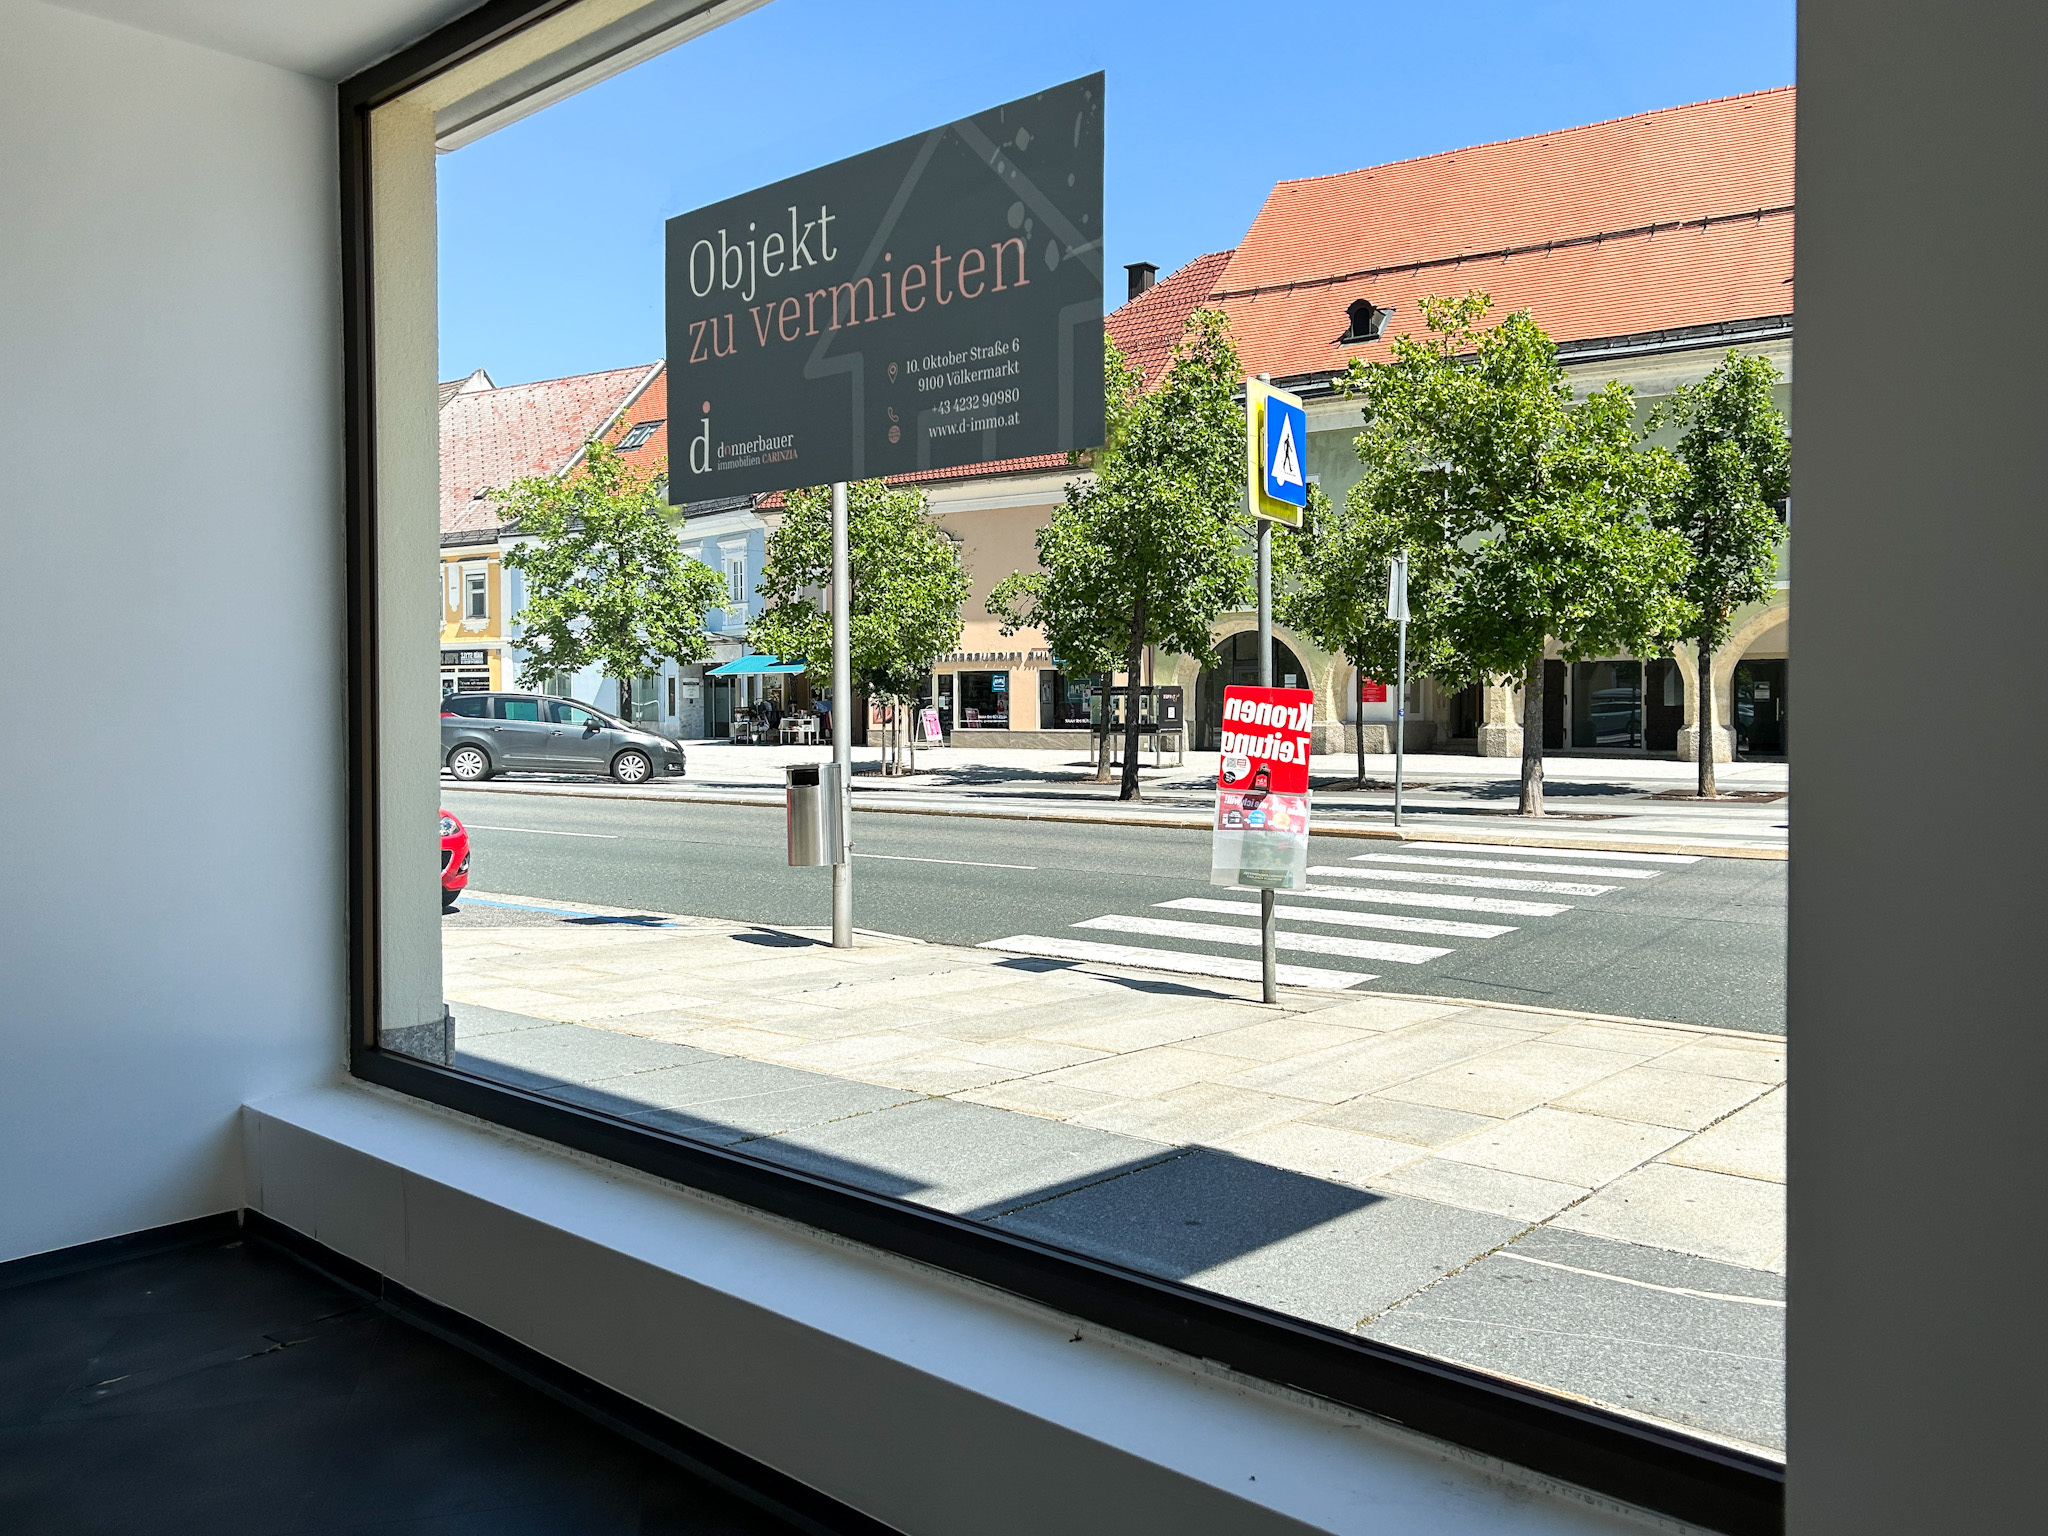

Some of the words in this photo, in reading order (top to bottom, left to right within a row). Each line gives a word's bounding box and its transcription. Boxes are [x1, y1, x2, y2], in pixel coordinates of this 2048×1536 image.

[689, 204, 837, 302] Objekt
[689, 313, 737, 364] zu
[749, 236, 1031, 347] vermieten
[906, 359, 920, 374] 10.
[922, 350, 968, 371] Oktober
[970, 340, 1009, 361] Straße
[1012, 337, 1020, 353] 6
[918, 374, 944, 392] 9100
[946, 360, 1020, 387] Völkermarkt
[931, 399, 951, 415] +43
[953, 394, 979, 413] 4232
[982, 387, 1020, 408] 90980
[928, 411, 1020, 438] www.d-immo.at
[717, 433, 794, 459] donnerbauer
[717, 454, 761, 471] immobilien
[761, 448, 799, 464] CARINZIA
